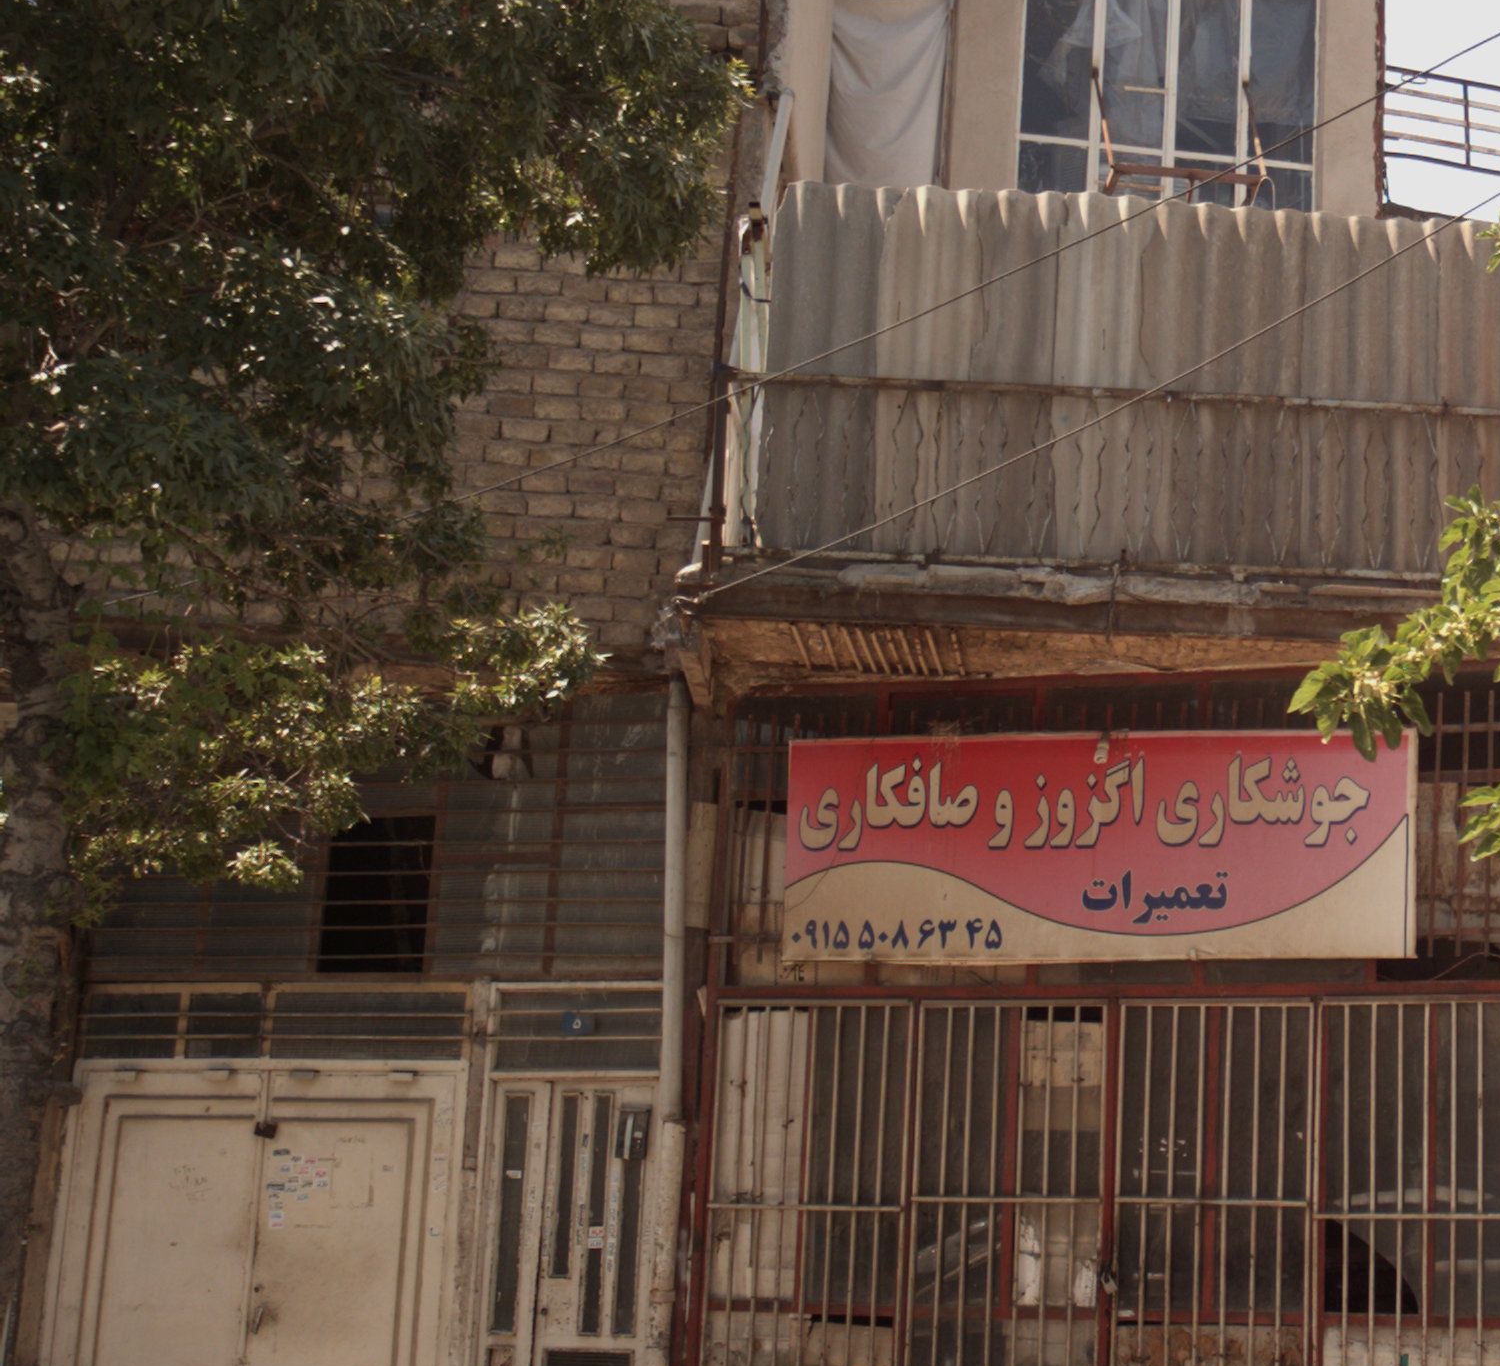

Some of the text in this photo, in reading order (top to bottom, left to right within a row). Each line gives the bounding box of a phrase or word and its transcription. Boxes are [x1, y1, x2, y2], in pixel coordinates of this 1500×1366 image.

[799, 752, 1370, 852] جوشکاری اگزوز و صافکاری
[1081, 868, 1229, 925] تعمیرات
[791, 918, 850, 950] ۰۹۱۵
